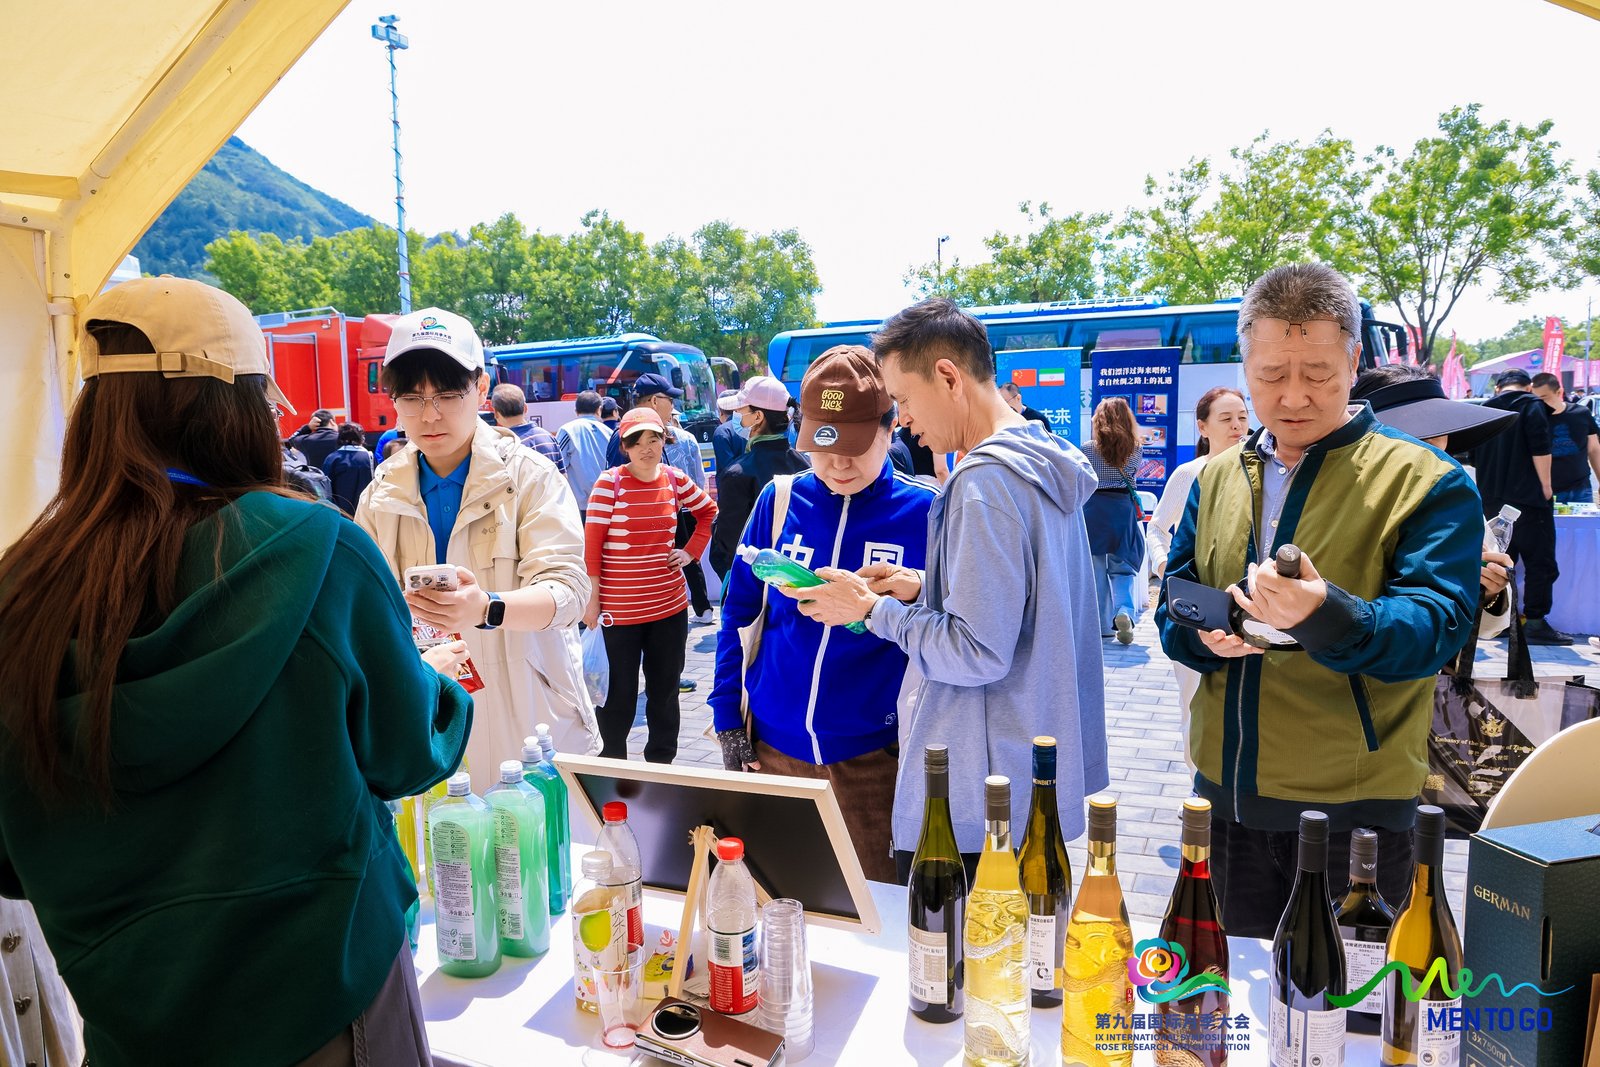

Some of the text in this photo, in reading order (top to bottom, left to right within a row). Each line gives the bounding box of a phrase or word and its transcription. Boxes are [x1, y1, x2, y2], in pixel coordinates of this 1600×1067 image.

[821, 389, 844, 400] GOOD
[820, 399, 844, 411] LUCK
[1473, 884, 1531, 921] GERMAN
